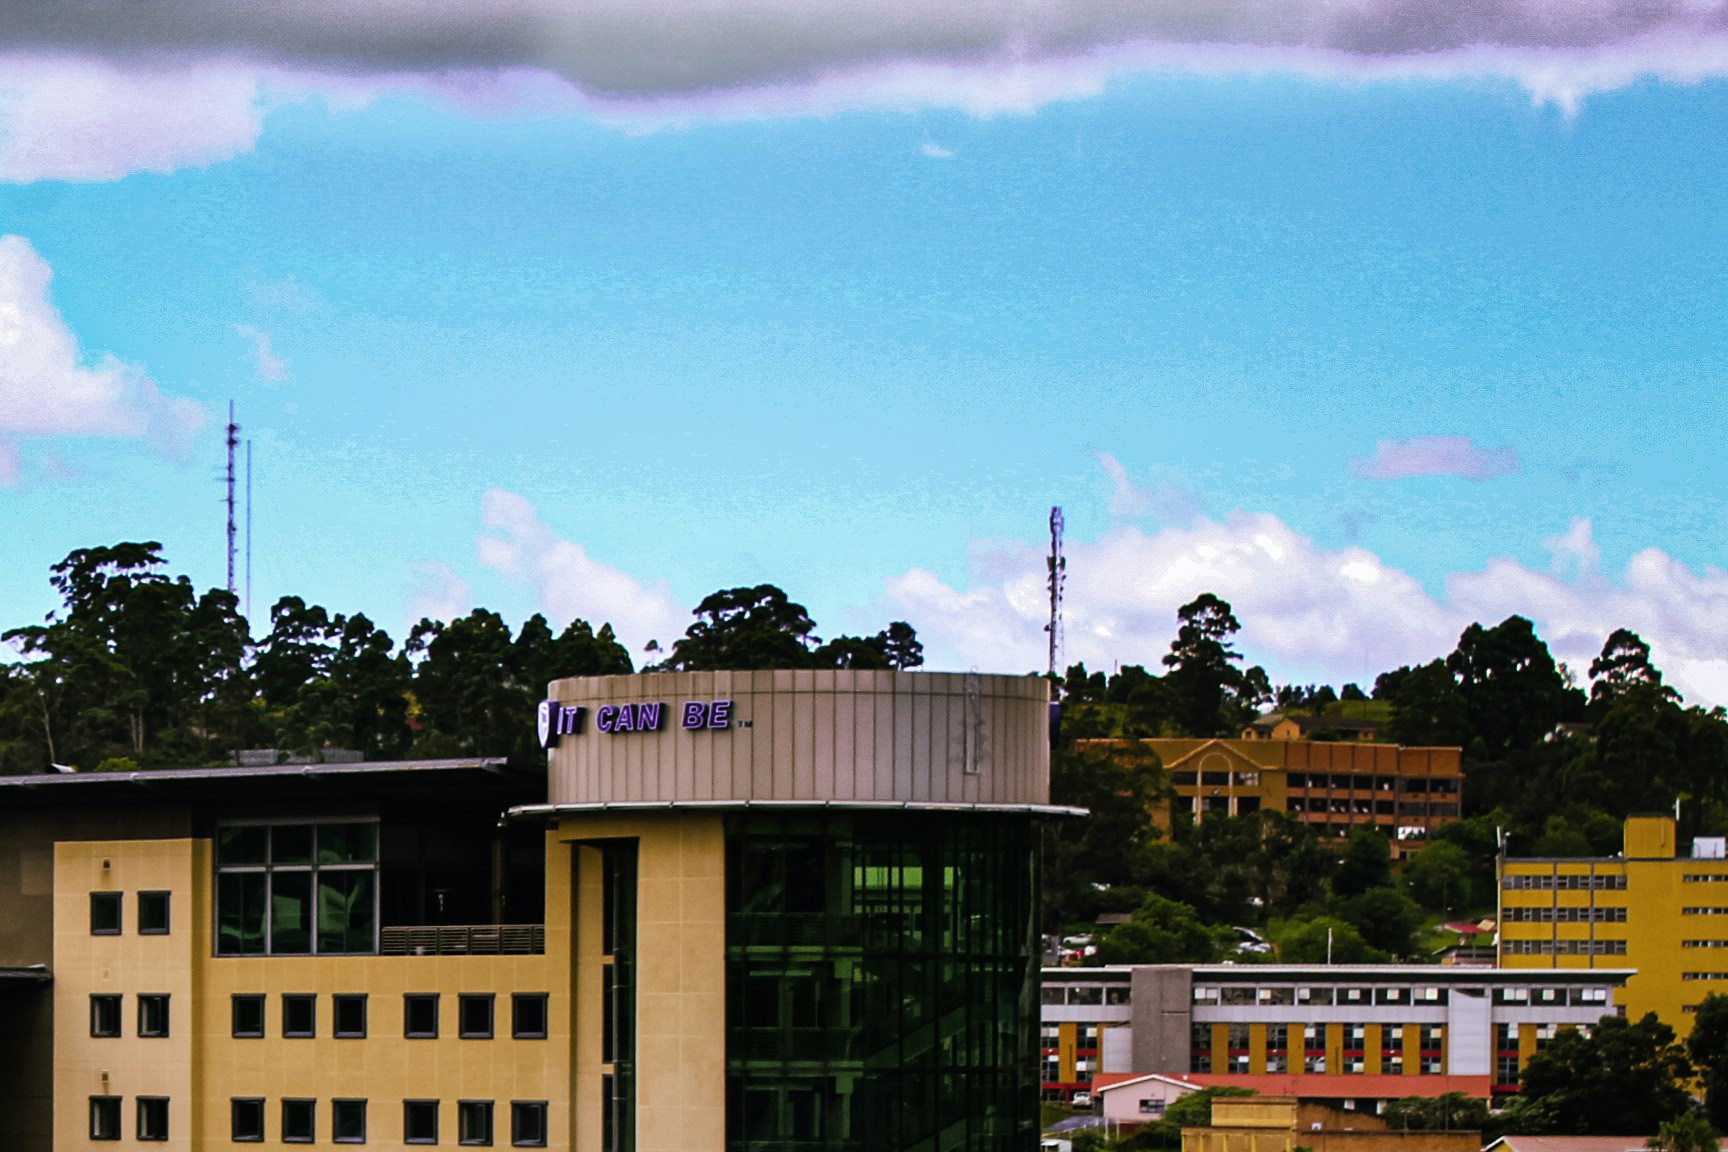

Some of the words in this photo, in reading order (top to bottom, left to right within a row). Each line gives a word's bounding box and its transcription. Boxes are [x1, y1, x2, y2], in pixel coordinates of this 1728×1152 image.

[557, 707, 578, 735] IT
[597, 703, 662, 732] CAN
[682, 700, 732, 729] BE
